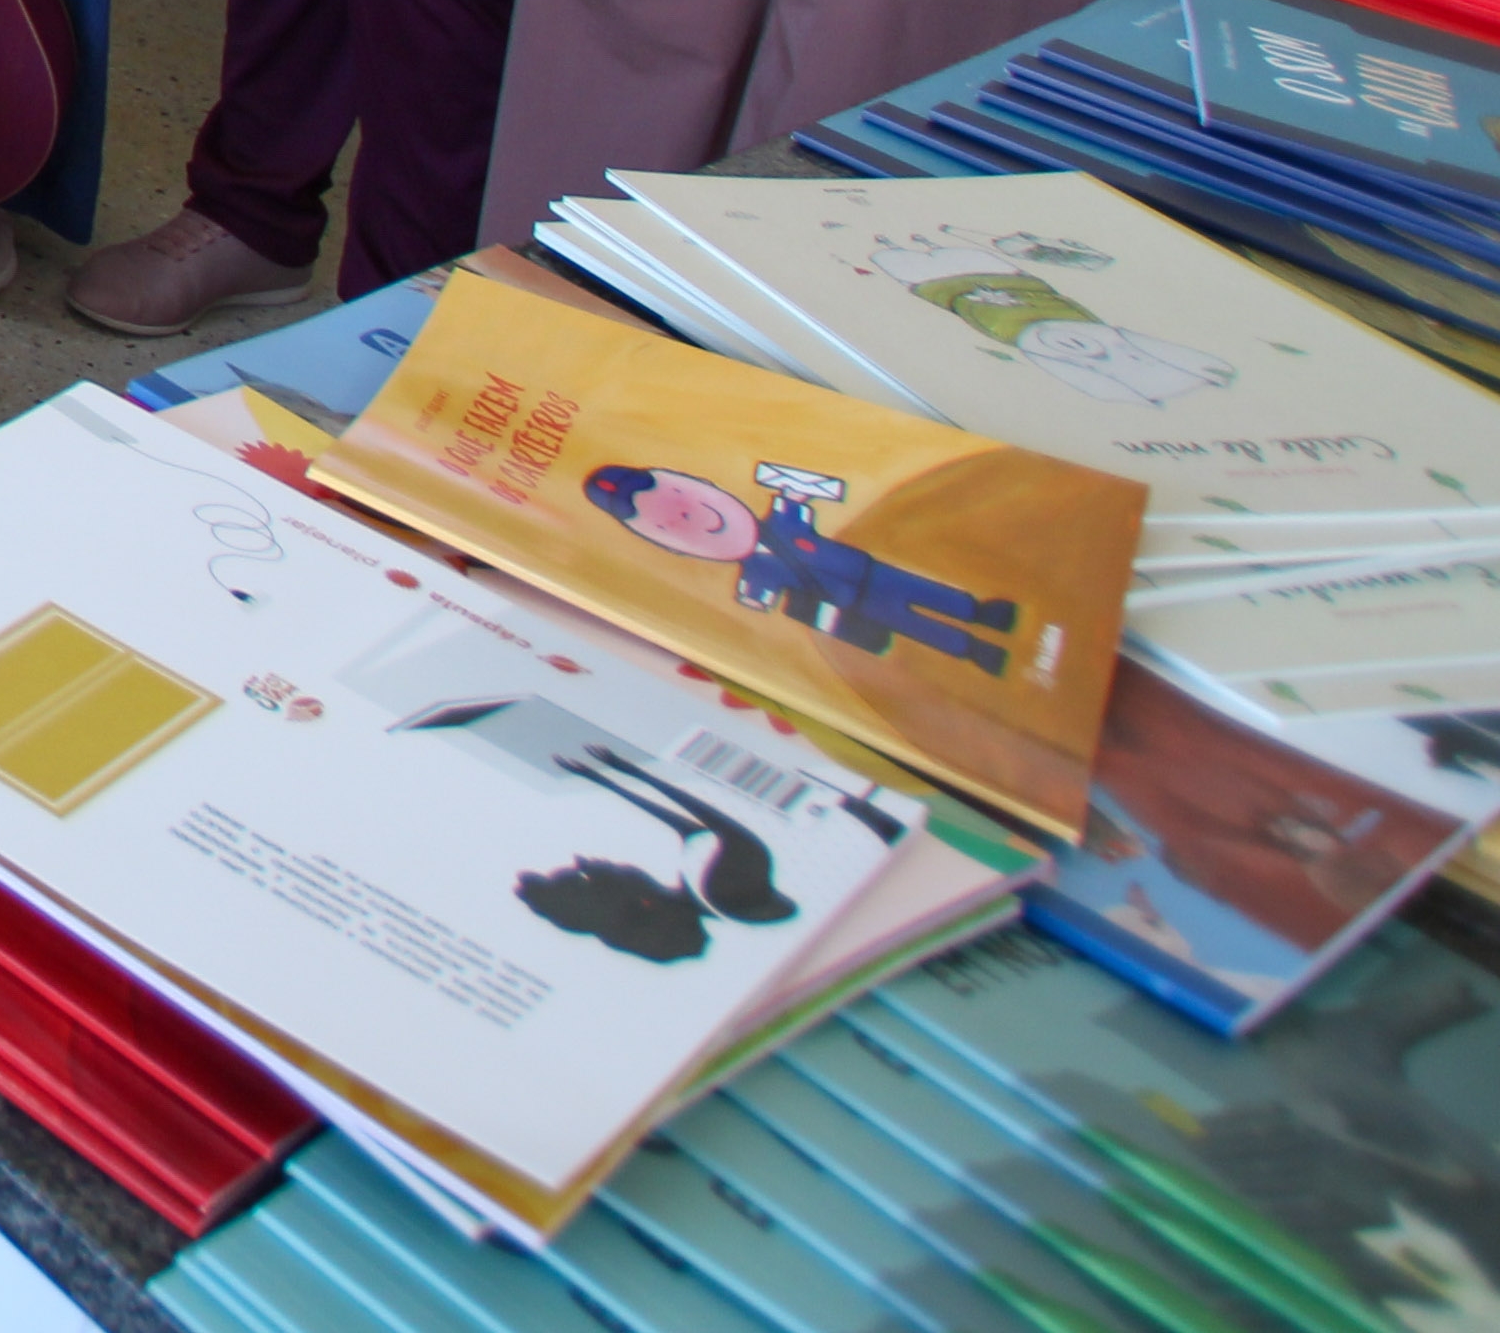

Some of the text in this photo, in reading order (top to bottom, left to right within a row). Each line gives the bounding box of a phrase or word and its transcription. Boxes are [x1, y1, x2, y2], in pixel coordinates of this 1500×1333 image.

[1249, 27, 1355, 106] O SOM
[463, 371, 525, 438] FAZEM
[499, 391, 580, 489] CARTEIROS
[445, 429, 495, 467] QUE
